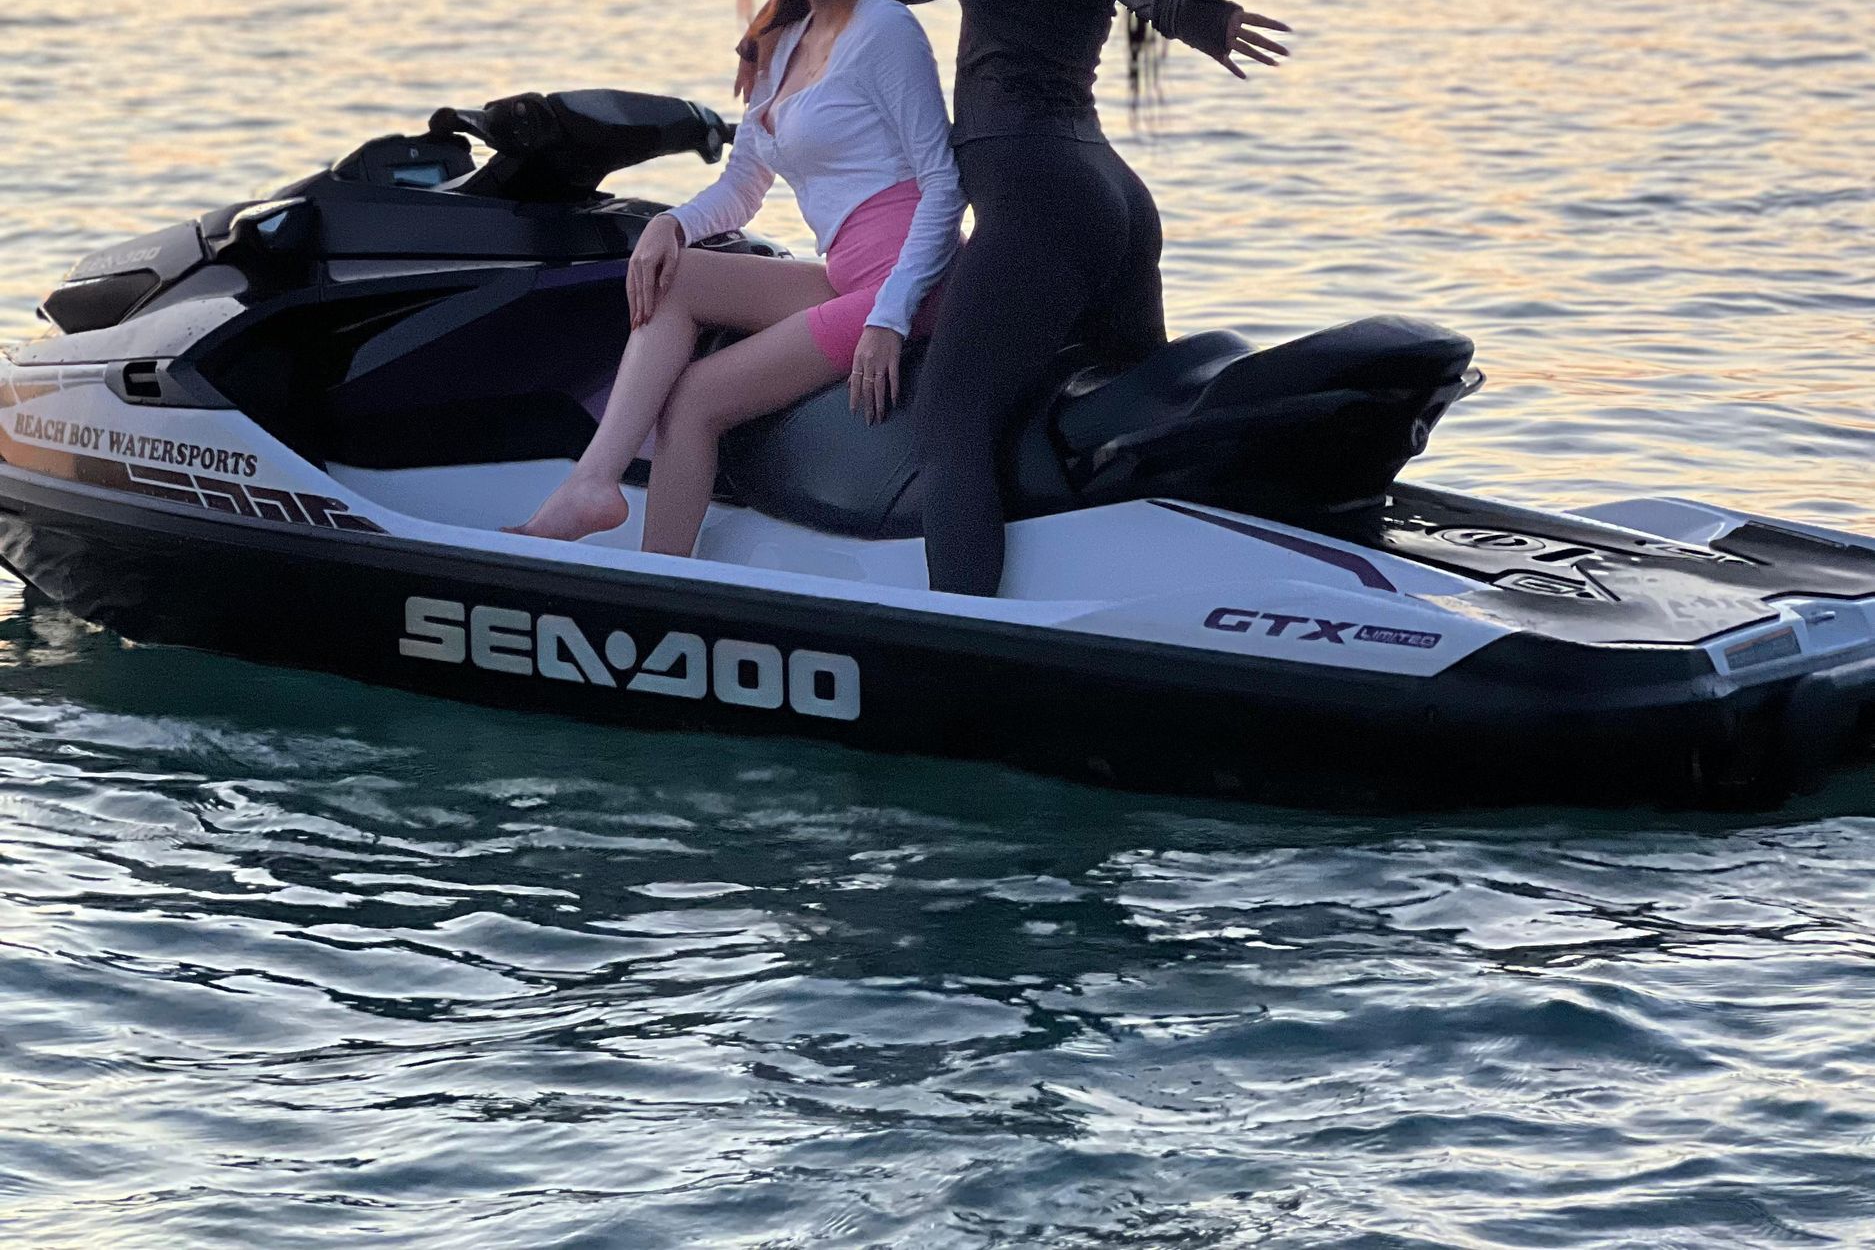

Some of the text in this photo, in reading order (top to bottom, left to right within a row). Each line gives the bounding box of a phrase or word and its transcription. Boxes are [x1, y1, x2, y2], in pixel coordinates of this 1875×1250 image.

[14, 412, 258, 478] BEACH BOY WATERSPORTS
[1203, 607, 1438, 647] GTX LIMITED
